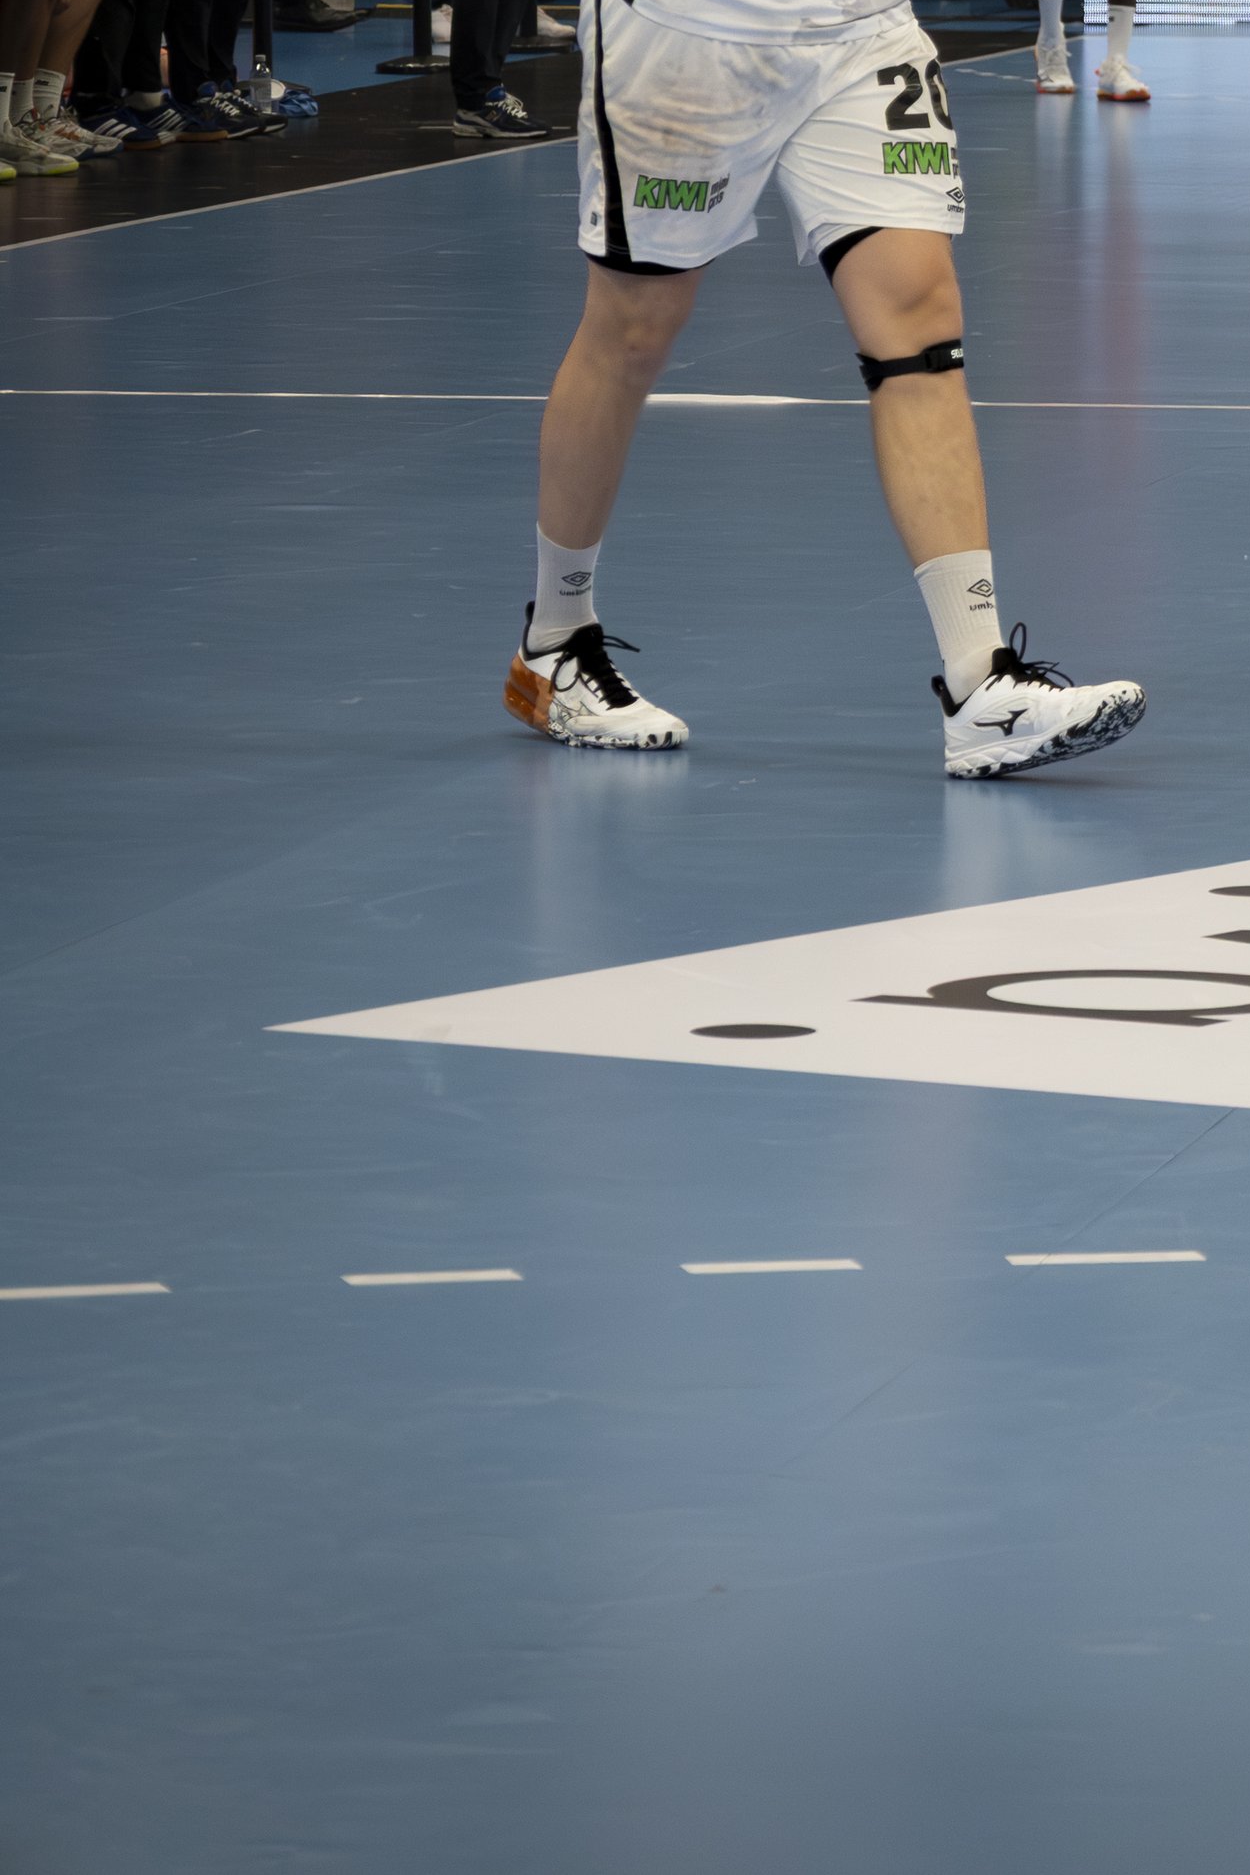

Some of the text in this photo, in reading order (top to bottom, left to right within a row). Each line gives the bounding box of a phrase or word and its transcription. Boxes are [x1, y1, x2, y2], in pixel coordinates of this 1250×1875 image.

[877, 59, 953, 131] 20
[882, 141, 951, 175] KIWI
[633, 174, 709, 213] KIWI
